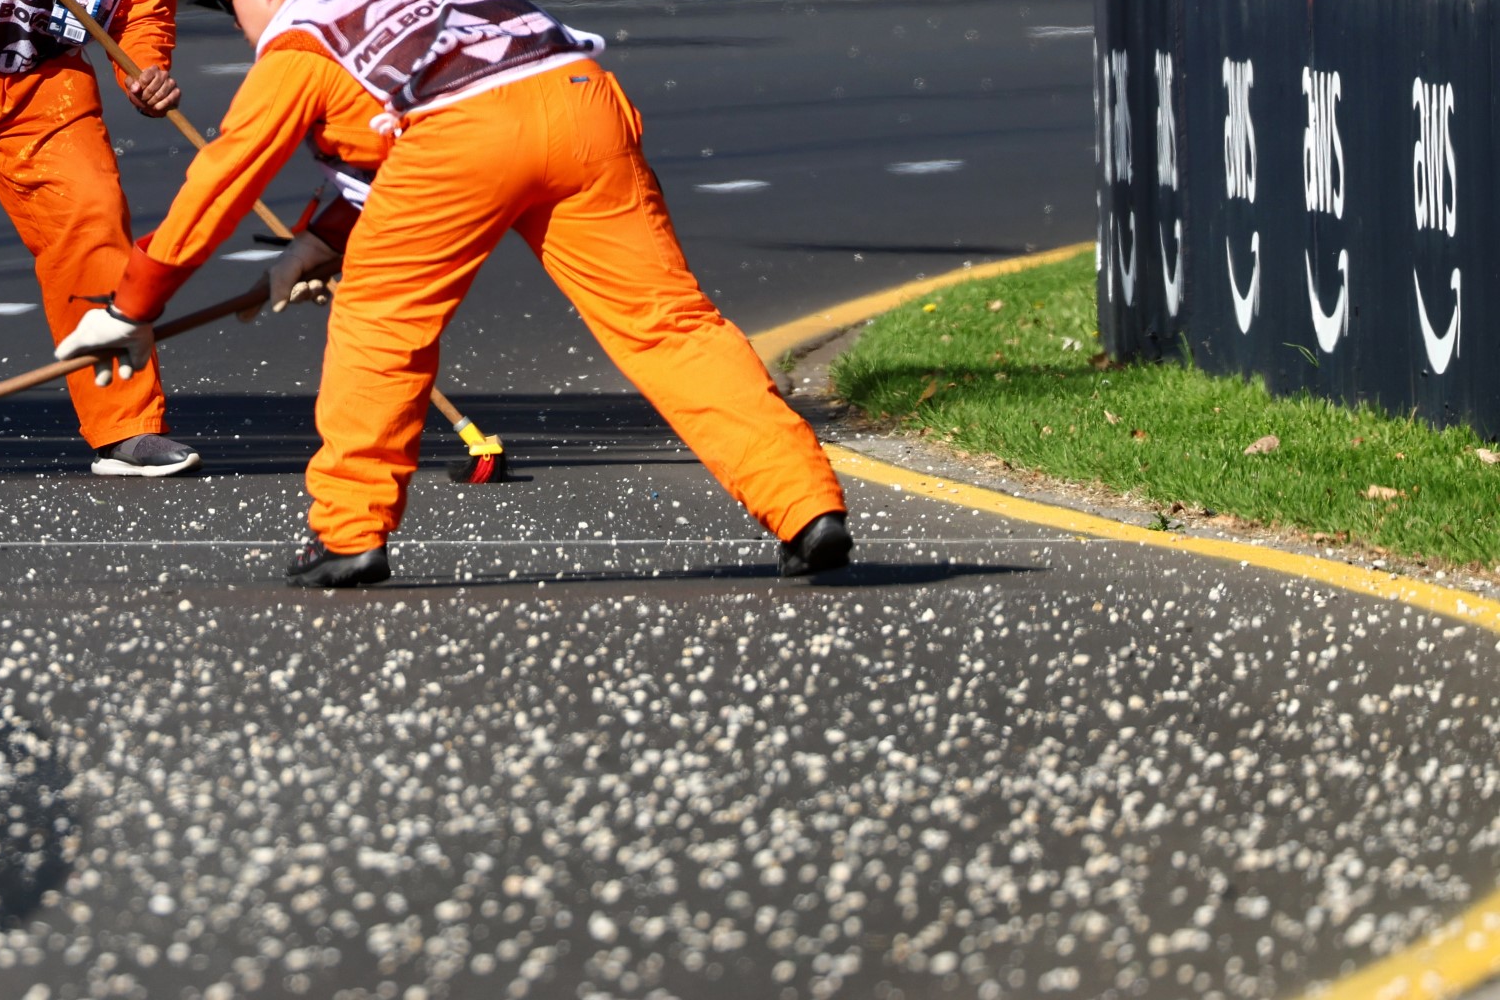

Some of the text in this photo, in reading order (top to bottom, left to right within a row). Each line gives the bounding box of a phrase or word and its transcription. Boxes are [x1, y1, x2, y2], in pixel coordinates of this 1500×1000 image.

[1222, 56, 1257, 203] aws
[1302, 66, 1344, 219] aws
[1412, 77, 1456, 237] aws
